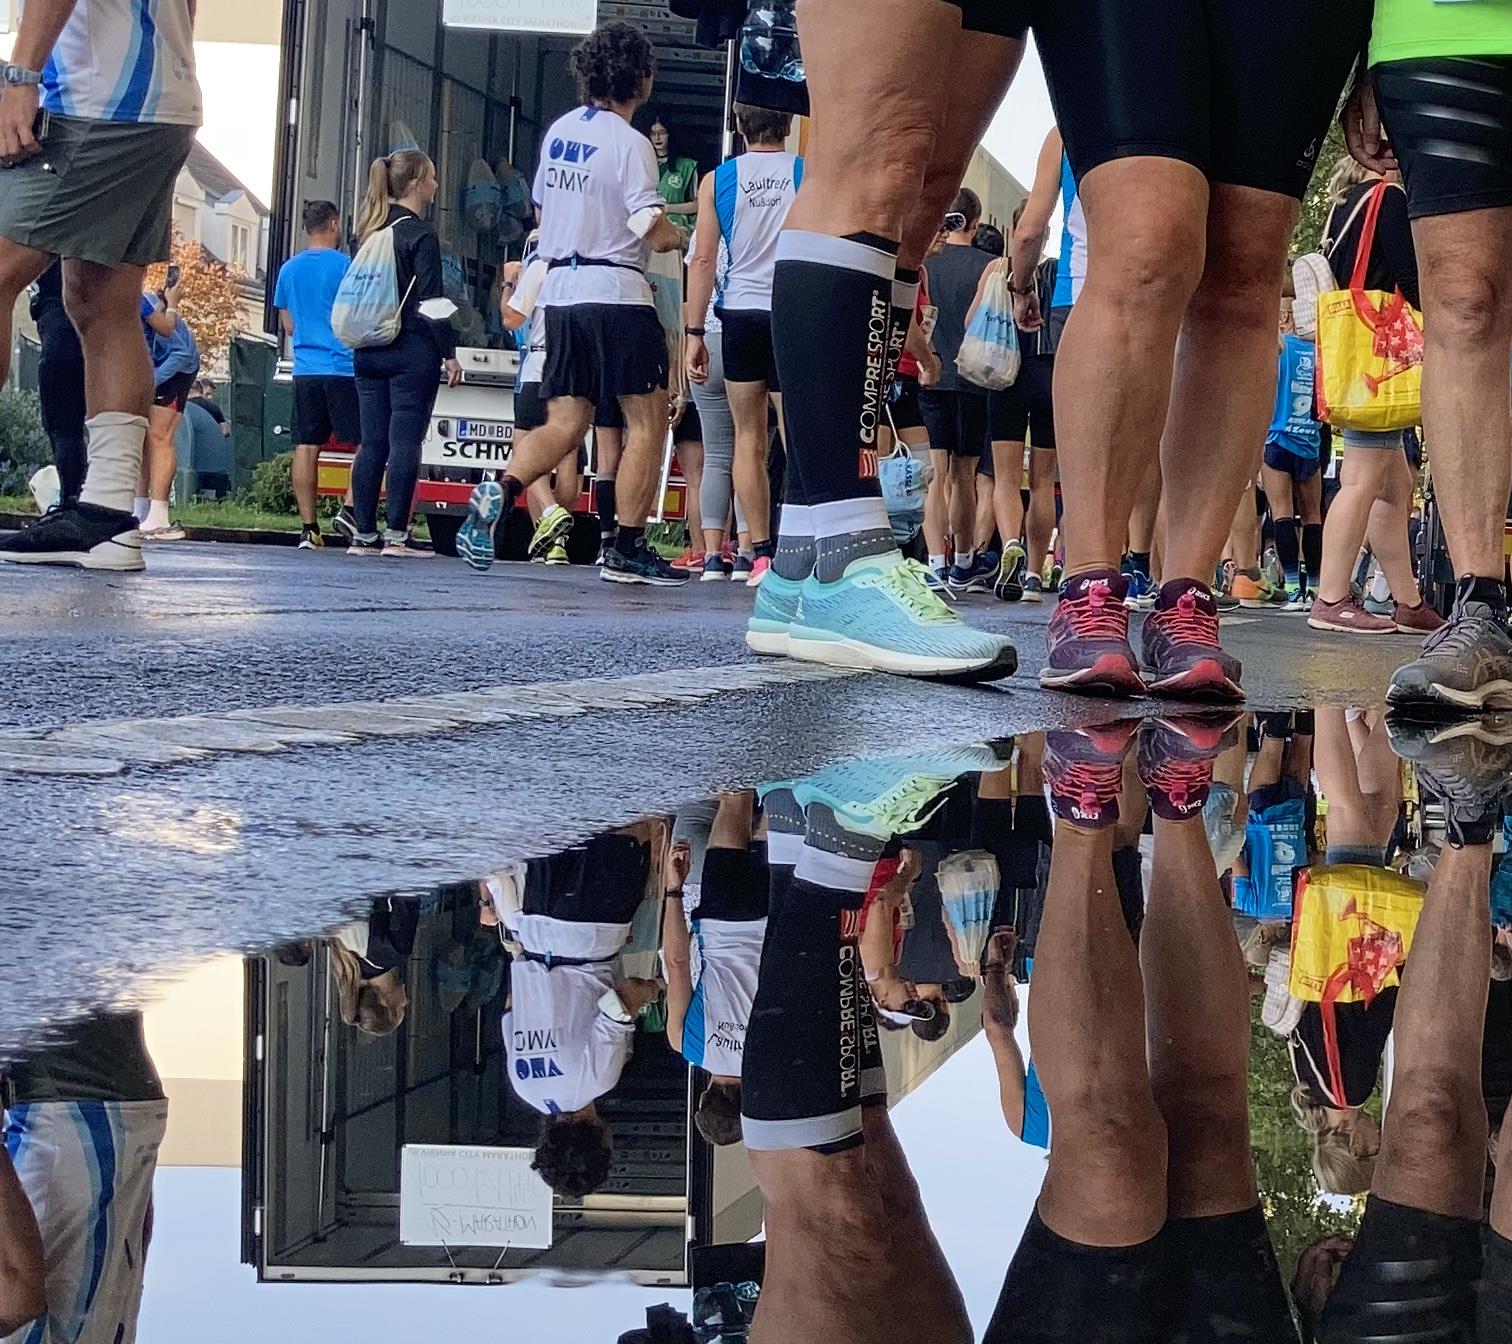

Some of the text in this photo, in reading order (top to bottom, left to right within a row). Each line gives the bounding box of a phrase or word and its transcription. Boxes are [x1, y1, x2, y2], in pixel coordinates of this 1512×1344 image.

[463, 16, 497, 24] VIENNA
[500, 17, 521, 25] CITY
[740, 177, 791, 193] Lauftreff
[470, 424, 486, 437] MD
